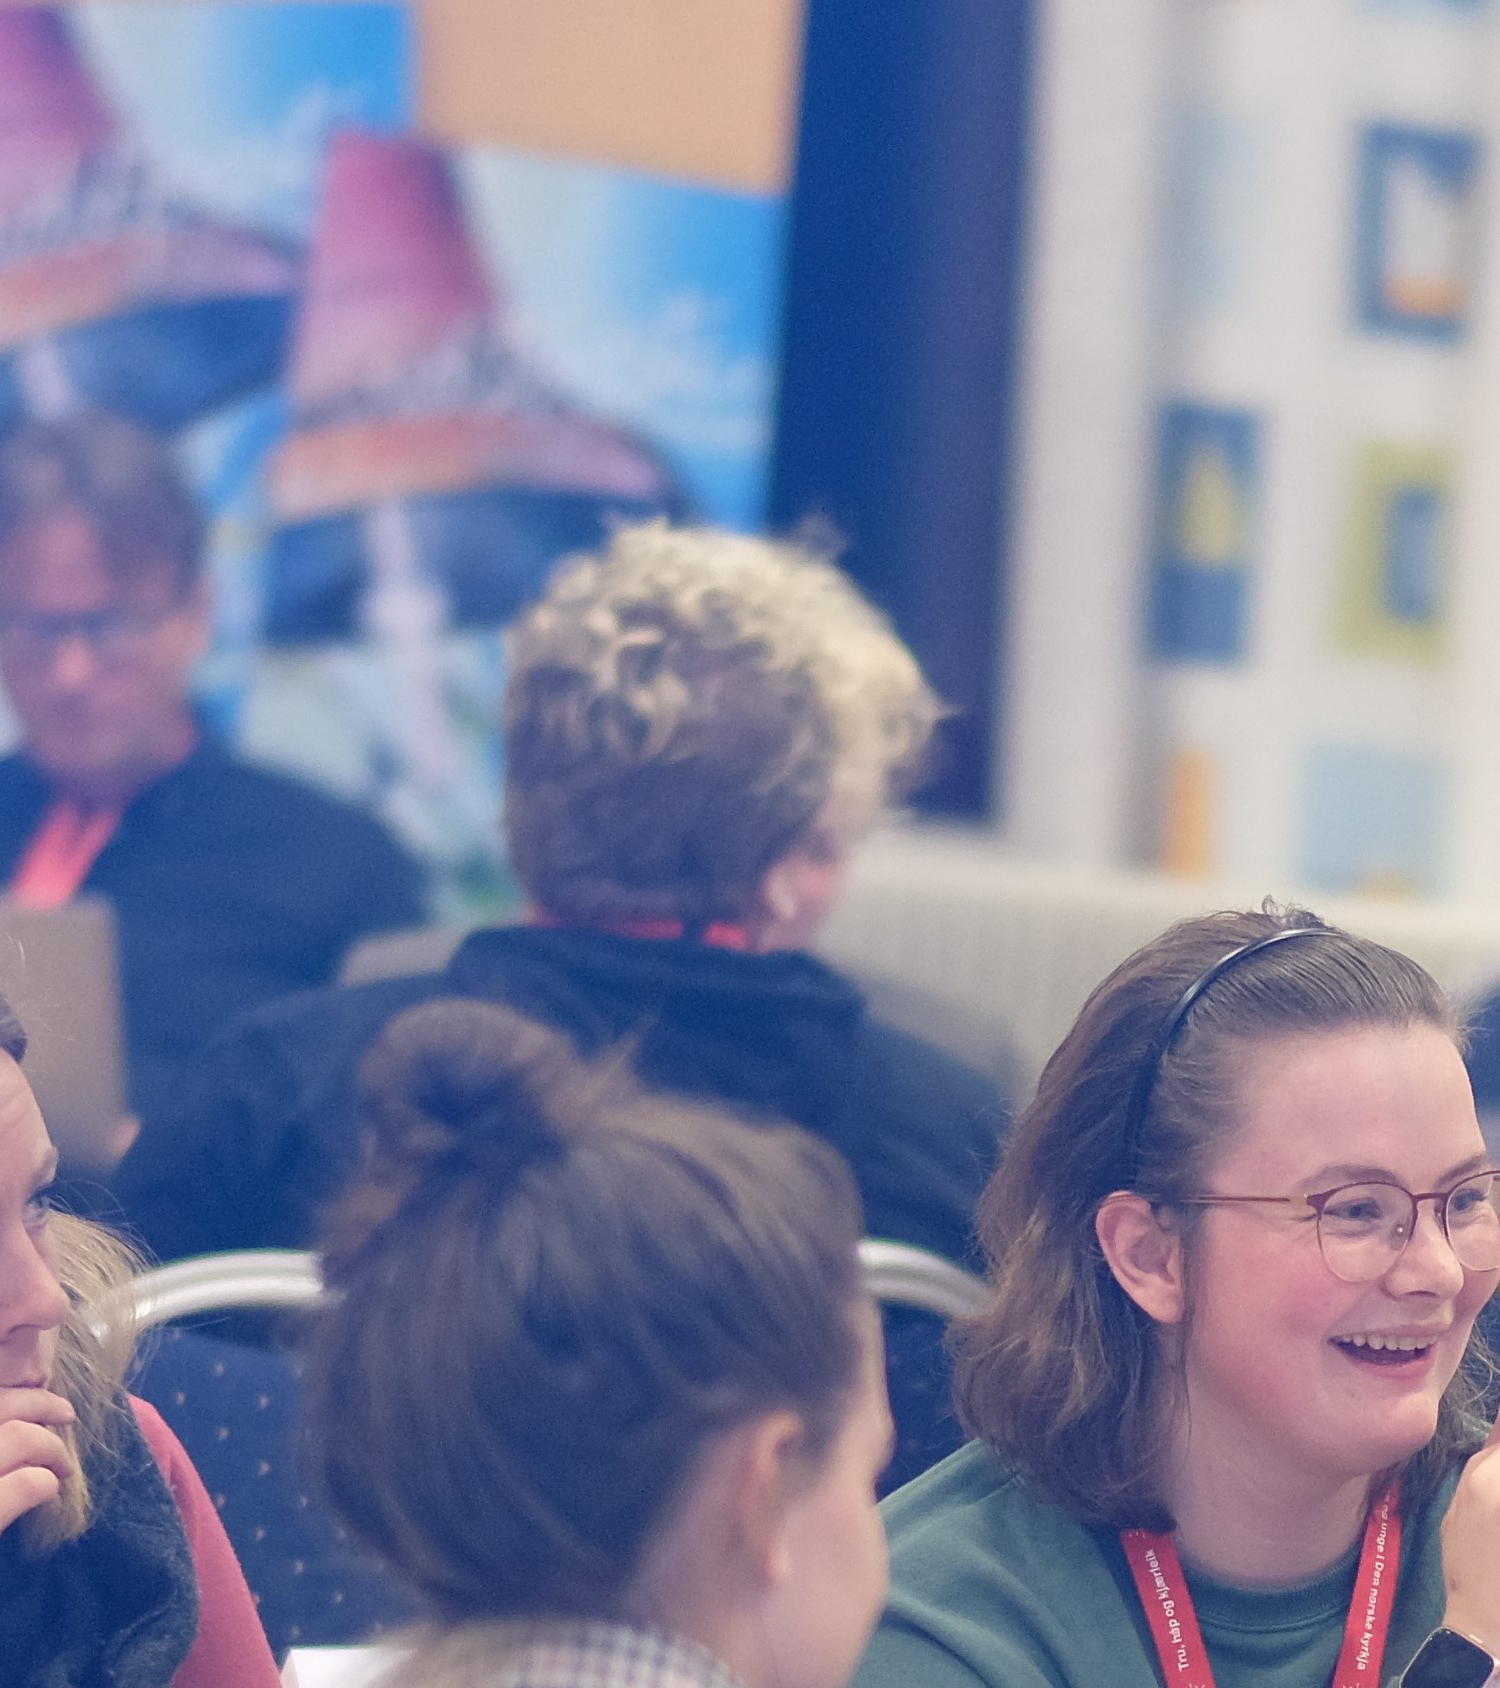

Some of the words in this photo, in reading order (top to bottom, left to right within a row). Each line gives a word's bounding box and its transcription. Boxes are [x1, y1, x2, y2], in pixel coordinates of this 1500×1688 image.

[1372, 1561, 1384, 1587] Den
[1162, 1600, 1175, 1617] og
[1364, 1588, 1378, 1630] norske
[1356, 1632, 1373, 1671] kyrkja
